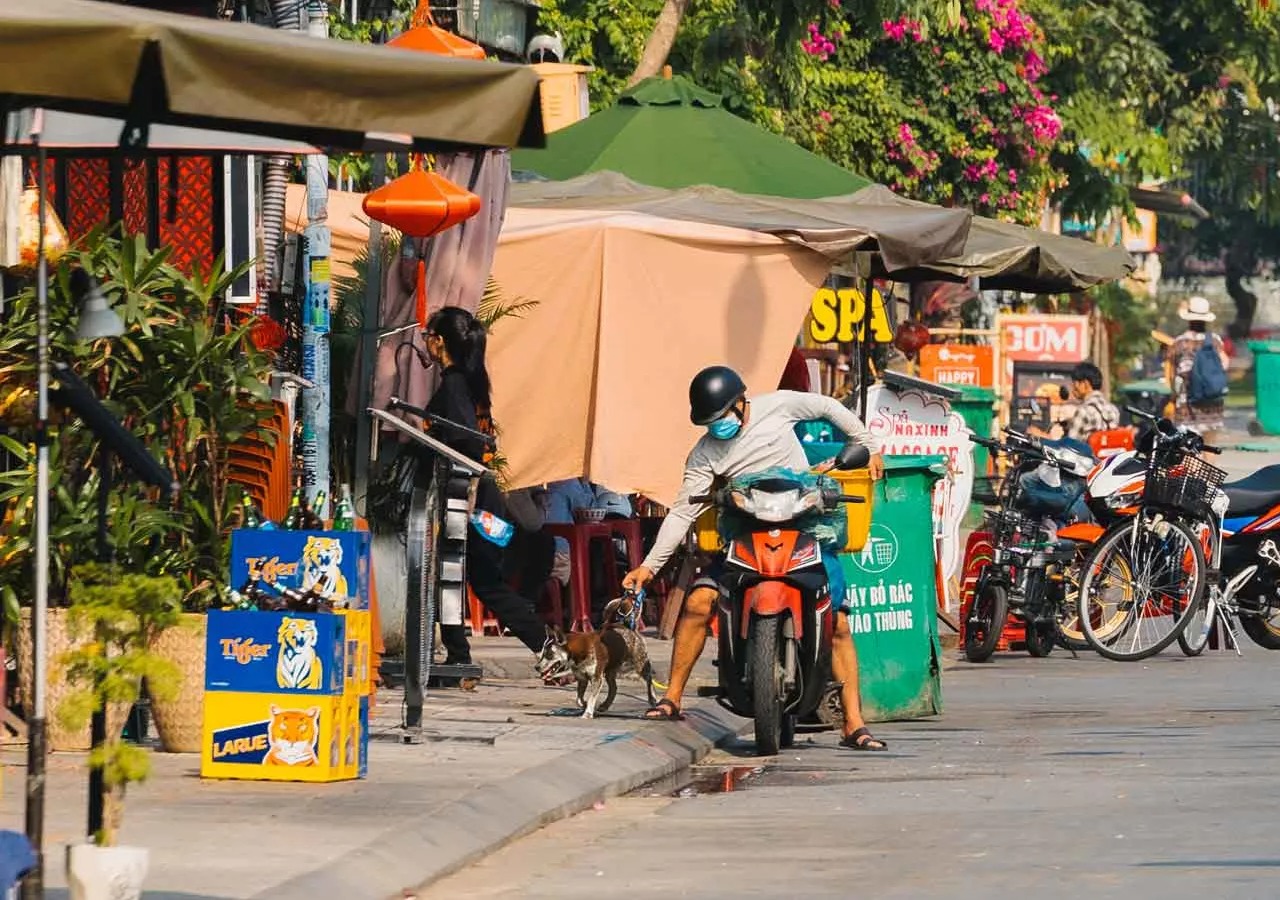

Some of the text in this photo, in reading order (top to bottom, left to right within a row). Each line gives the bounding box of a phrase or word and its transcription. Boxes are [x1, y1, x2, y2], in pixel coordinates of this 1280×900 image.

[810, 287, 893, 342] SPA
[938, 370, 975, 384] HAPPY
[245, 556, 298, 584] Tger
[870, 578, 886, 607] BỎ
[889, 579, 913, 605] RÁC
[847, 606, 913, 635] VÀO THÙNG
[219, 637, 272, 665] Tiger
[213, 733, 268, 759] LARUE
